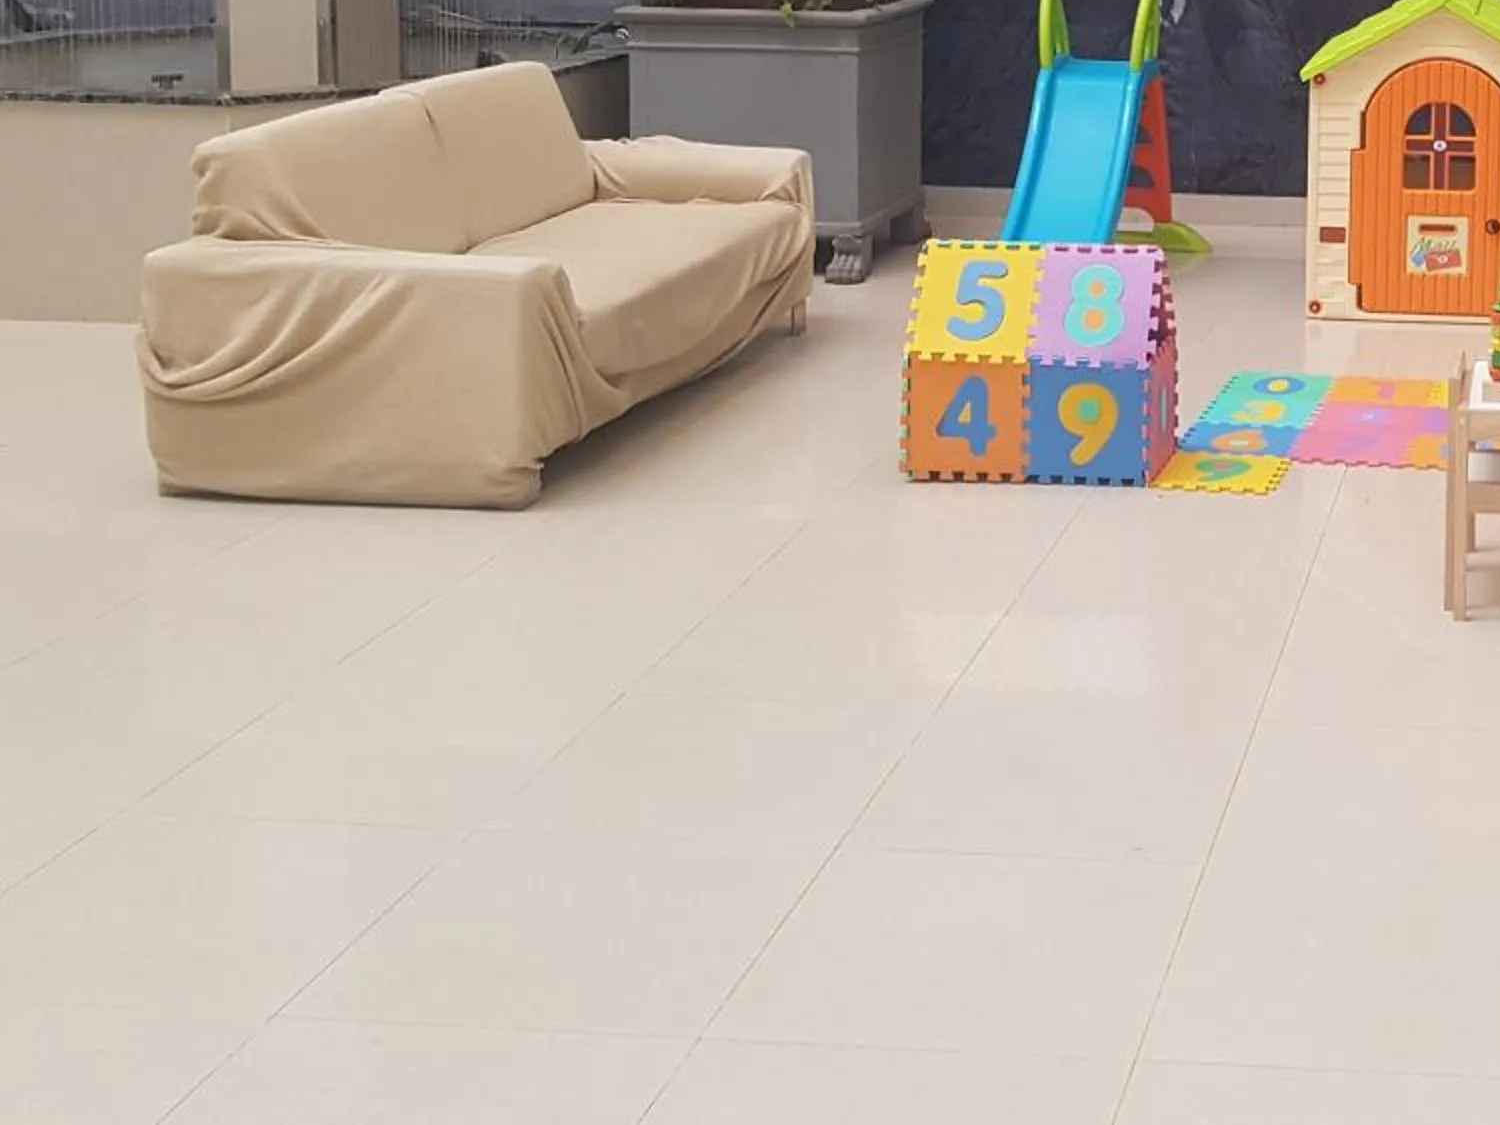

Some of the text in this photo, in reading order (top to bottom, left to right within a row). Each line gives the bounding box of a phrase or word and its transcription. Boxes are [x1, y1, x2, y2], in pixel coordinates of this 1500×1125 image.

[946, 260, 1008, 341] 5
[1064, 264, 1125, 347] 8
[936, 376, 996, 456] 4
[1058, 383, 1119, 466] 9
